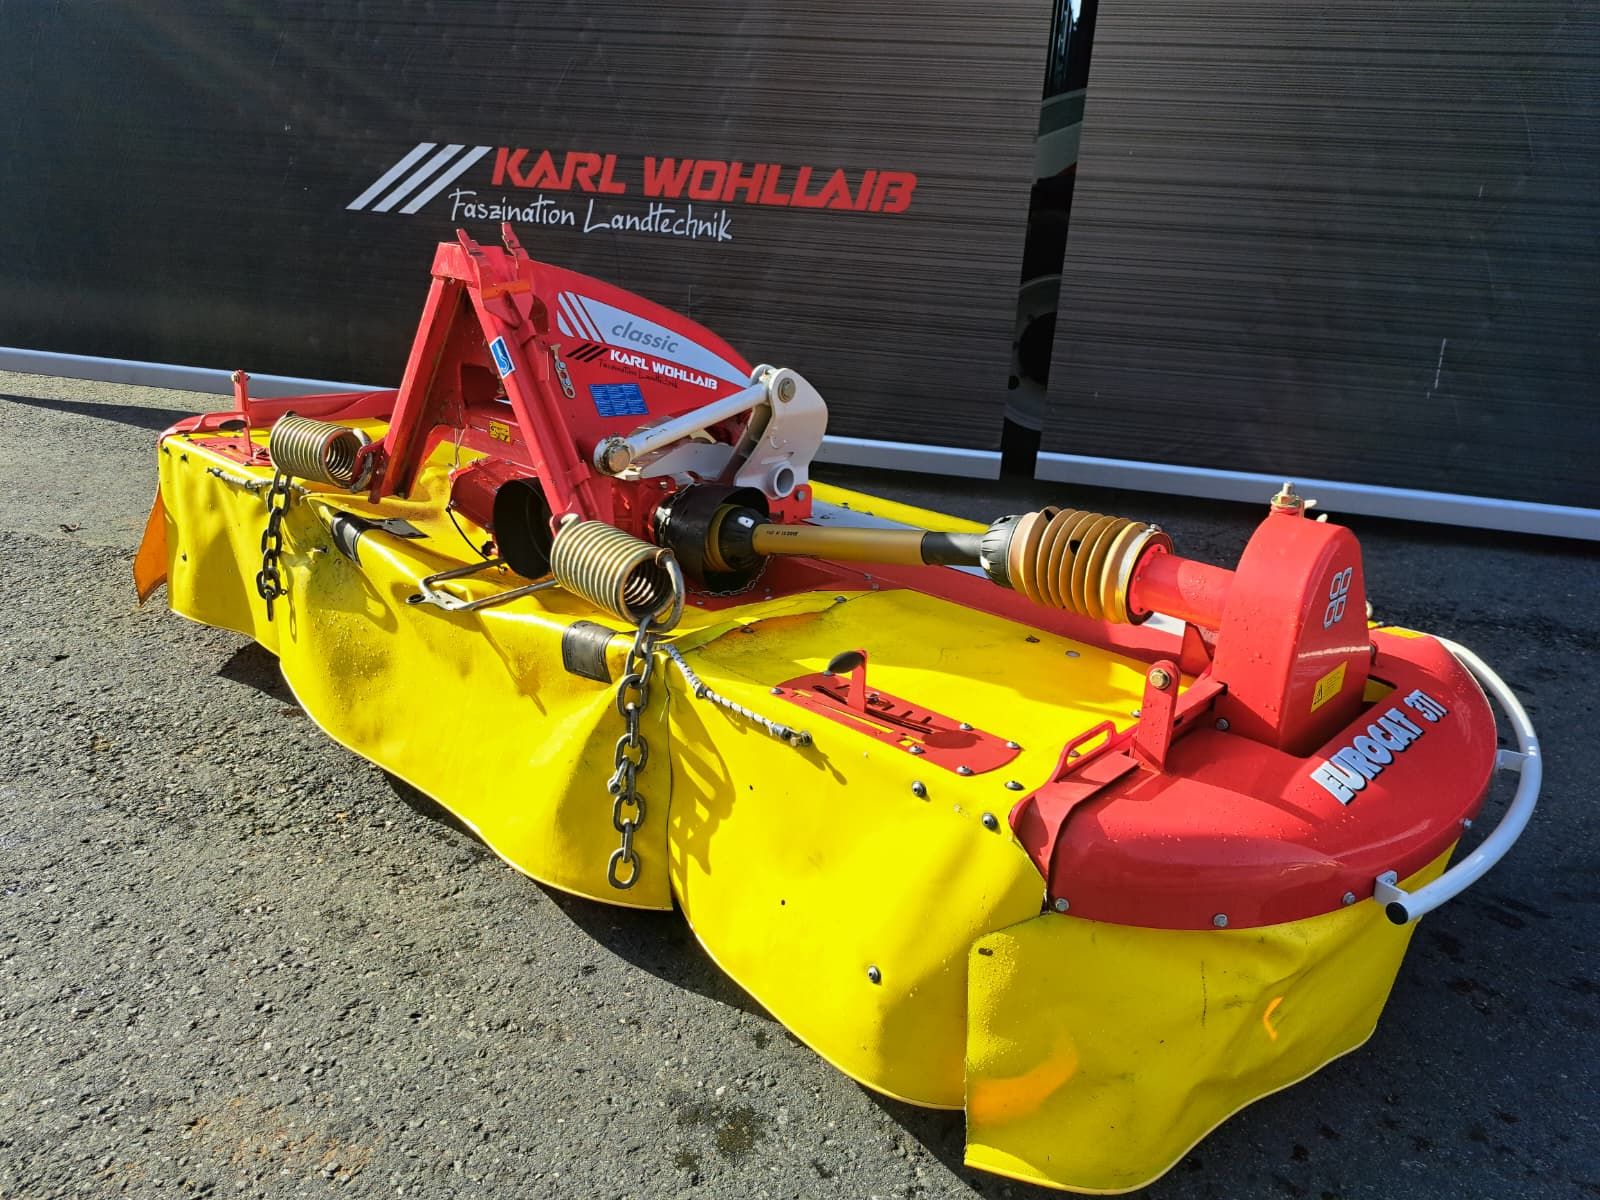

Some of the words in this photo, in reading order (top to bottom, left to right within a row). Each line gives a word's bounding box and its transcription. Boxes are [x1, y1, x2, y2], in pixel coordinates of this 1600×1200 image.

[491, 146, 626, 194] KARL
[448, 188, 576, 226] Faszination
[583, 199, 734, 243] Landtechnik
[610, 349, 649, 371] KARL
[611, 321, 679, 354] classic
[1310, 707, 1424, 806] EUROCAT
[1403, 689, 1448, 722] 311
